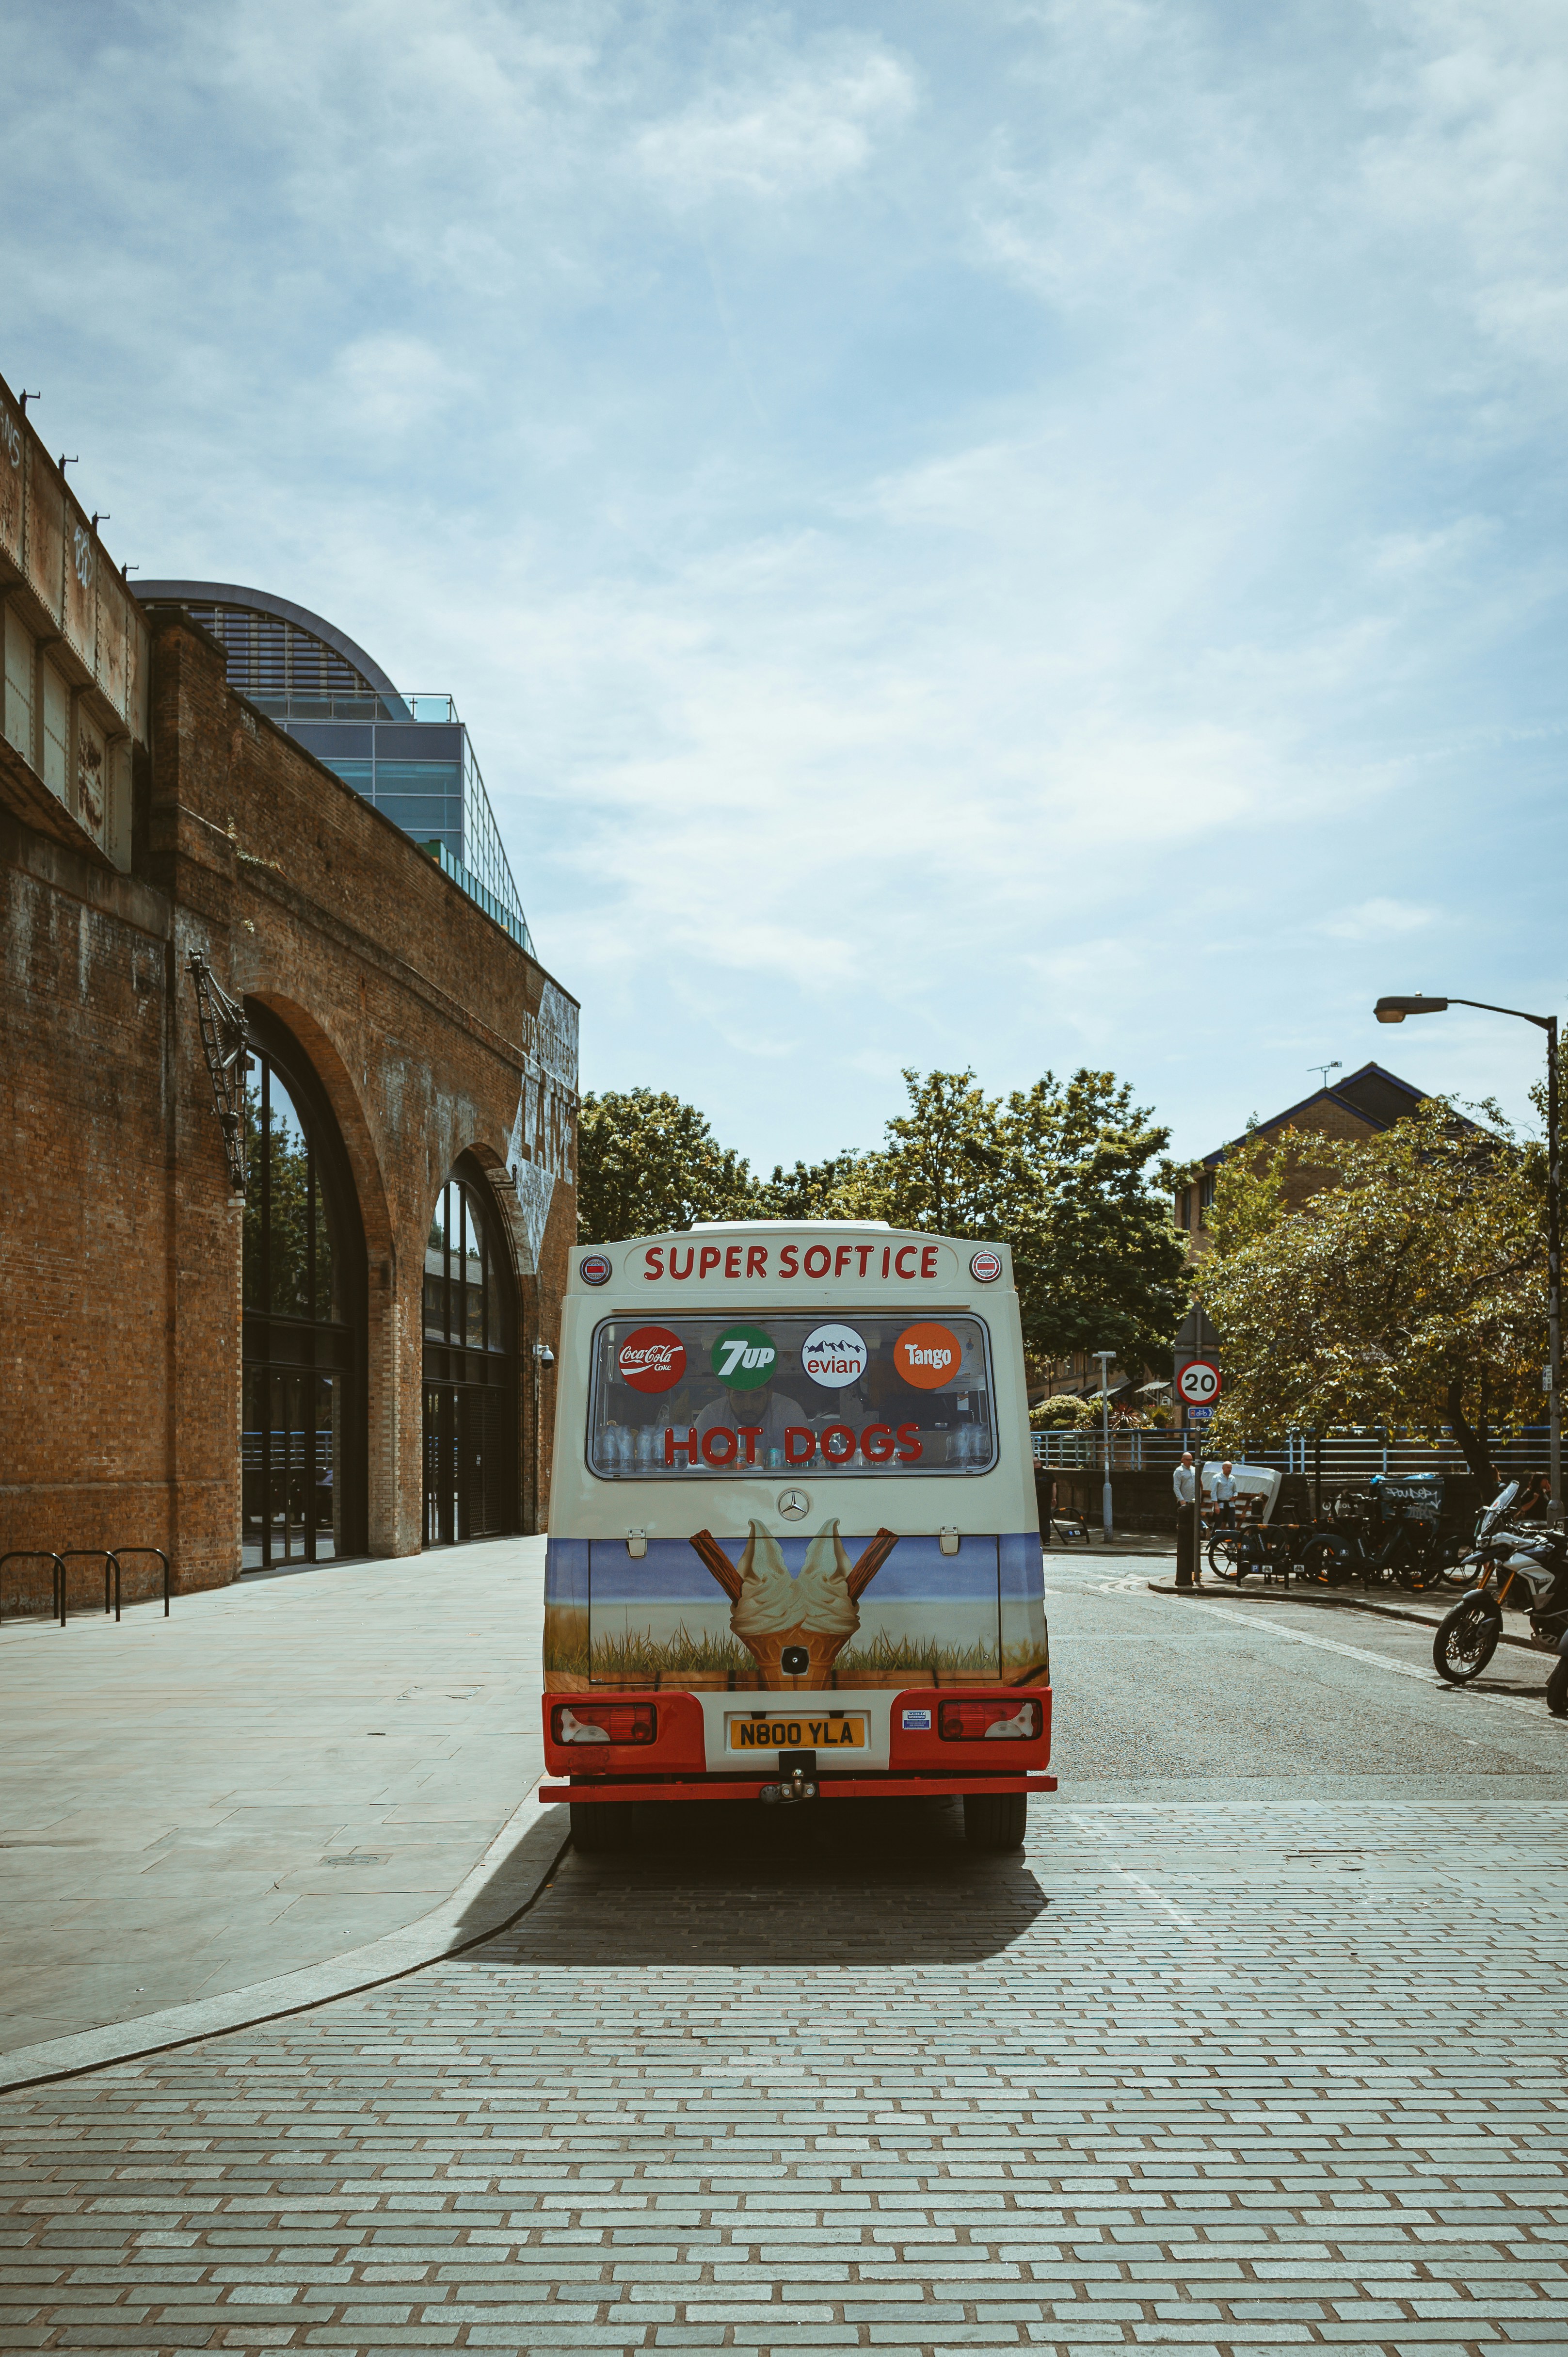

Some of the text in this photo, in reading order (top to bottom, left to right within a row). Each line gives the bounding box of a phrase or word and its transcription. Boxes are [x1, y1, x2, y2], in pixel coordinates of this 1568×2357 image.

[643, 1244, 939, 1281] SUPER SOFT ICE
[620, 1345, 672, 1364] Coca-Cola
[718, 1340, 775, 1375] 7UP
[807, 1356, 861, 1373] evian
[904, 1344, 952, 1369] Tango
[1184, 1373, 1216, 1392] 20
[665, 1422, 923, 1465] HOT DOGS
[741, 1722, 853, 1745] N800 YLA
